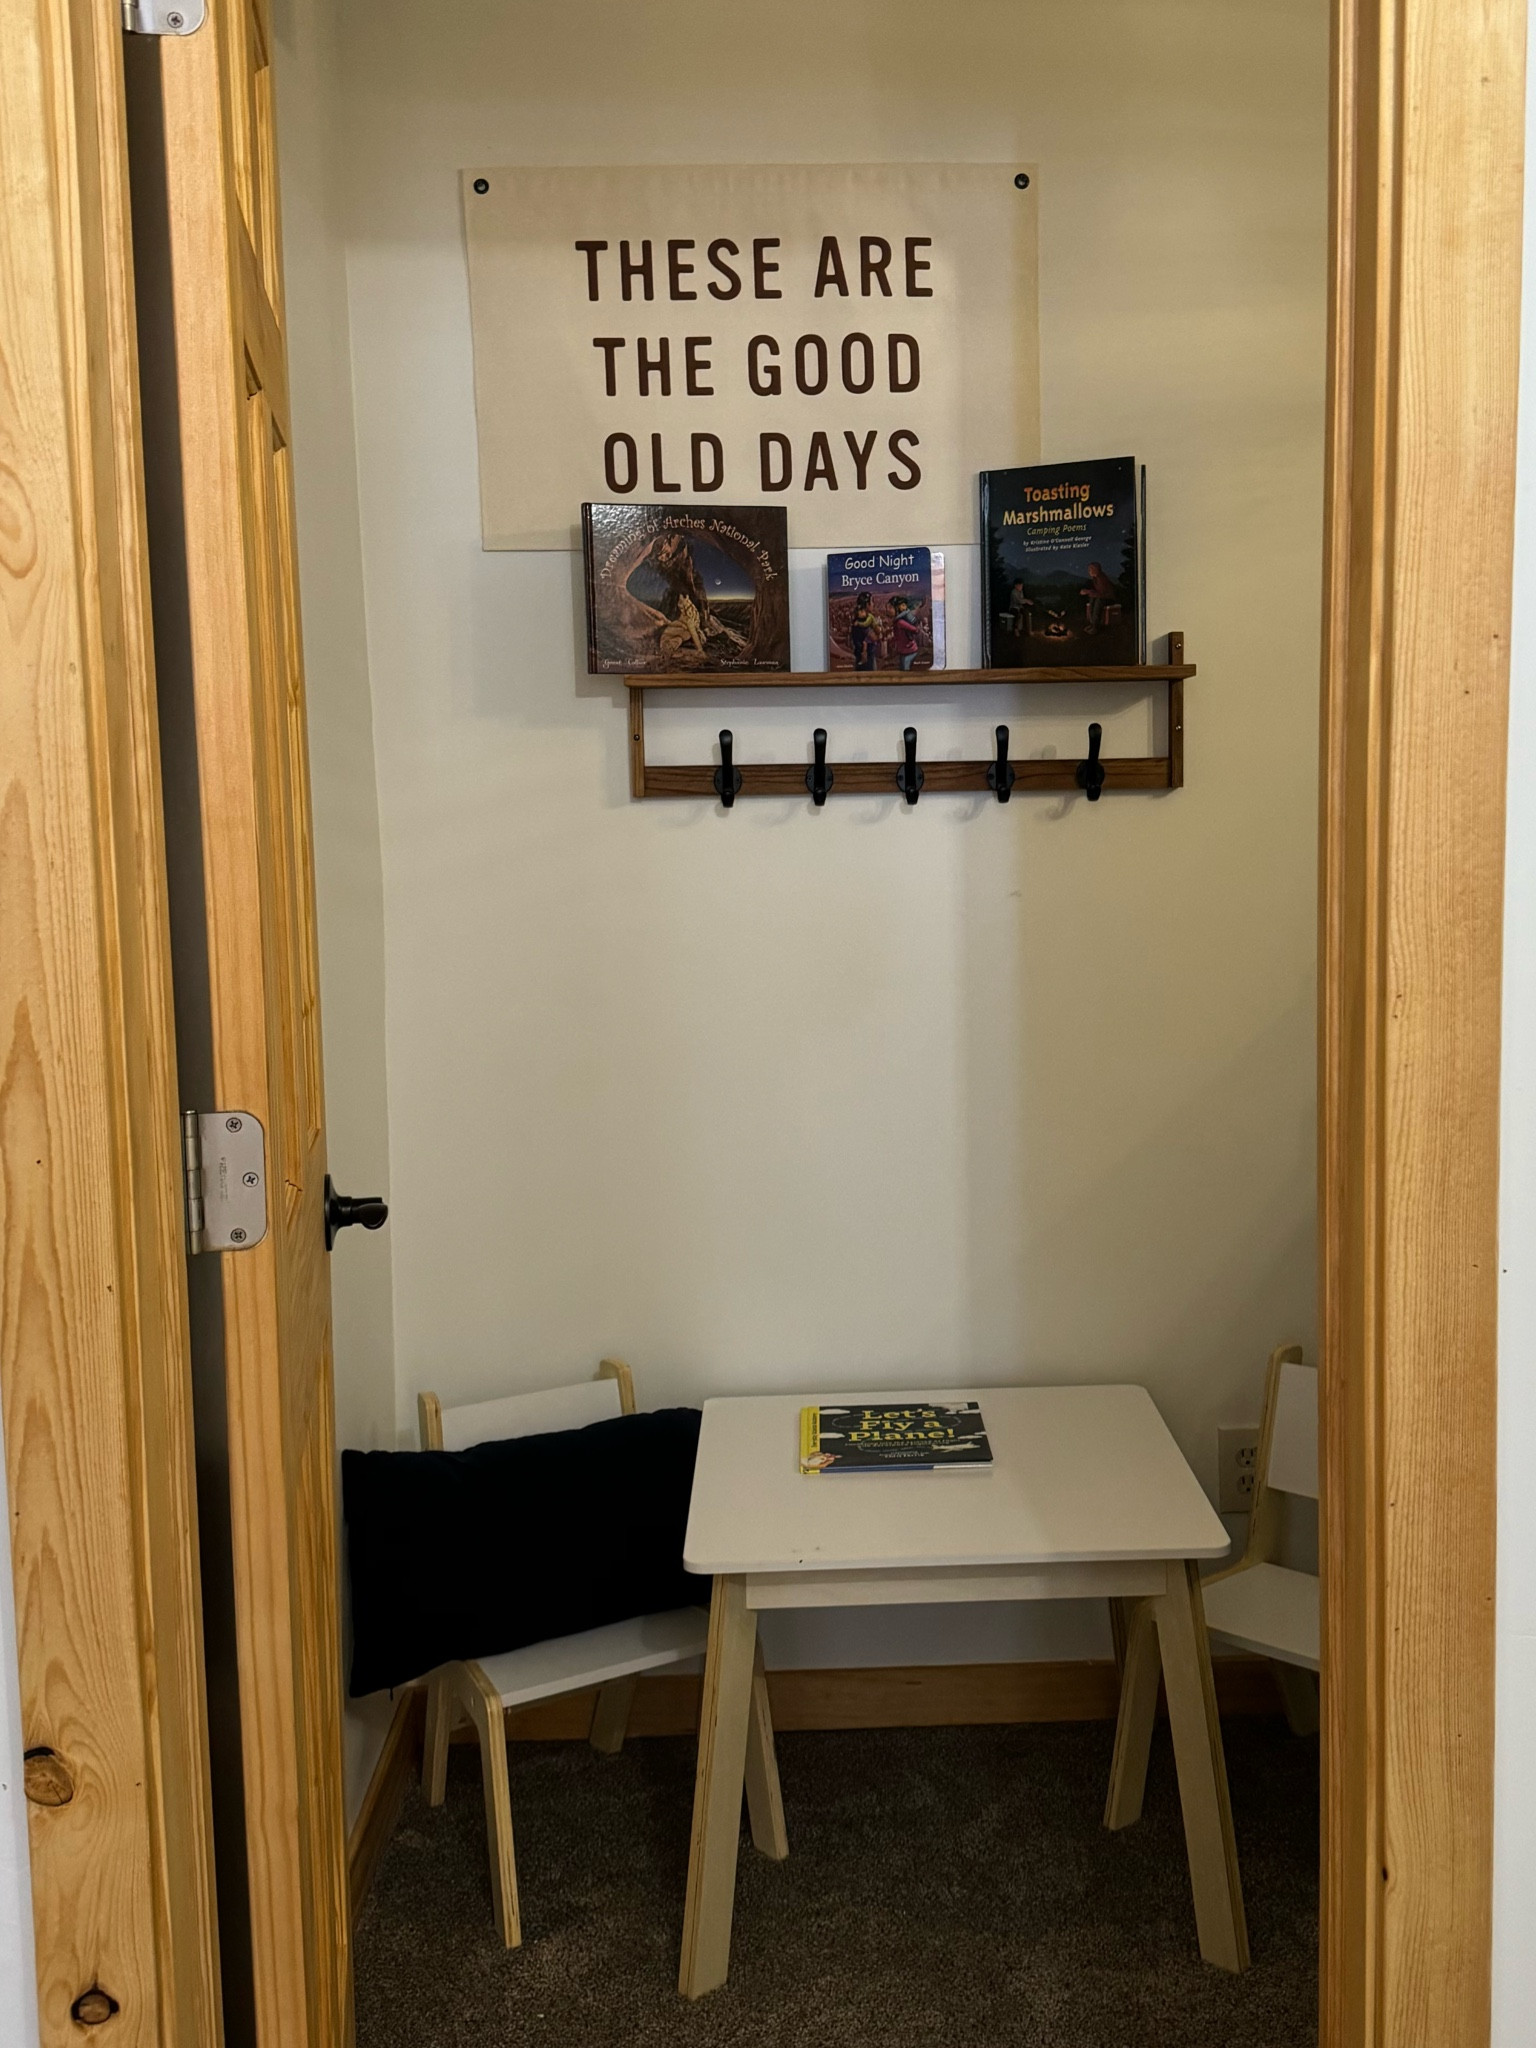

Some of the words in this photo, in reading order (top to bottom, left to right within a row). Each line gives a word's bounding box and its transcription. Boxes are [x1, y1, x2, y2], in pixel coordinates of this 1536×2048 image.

[574, 237, 782, 302] THESE
[814, 235, 933, 298] ARE
[592, 335, 715, 397] THE
[747, 331, 921, 397] GOOD
[603, 431, 724, 494] OLD
[758, 429, 922, 492] DAYS
[1024, 482, 1090, 503] Toasting
[1003, 502, 1114, 526] Marshmallows
[1026, 525, 1060, 537] Camping
[1062, 523, 1087, 533] Poems
[600, 529, 646, 579] Dreaming
[646, 517, 660, 533] of
[662, 514, 706, 530] Arches
[708, 518, 760, 553] National
[757, 549, 778, 581] Park
[844, 556, 875, 570] Good
[880, 553, 914, 570] Night
[841, 574, 873, 590] Bryce
[875, 572, 920, 588] Canyon
[862, 1408, 937, 1420] Let's
[848, 1428, 955, 1442] Plane!
[860, 1420, 914, 1432] Fly
[923, 1420, 942, 1429] a
